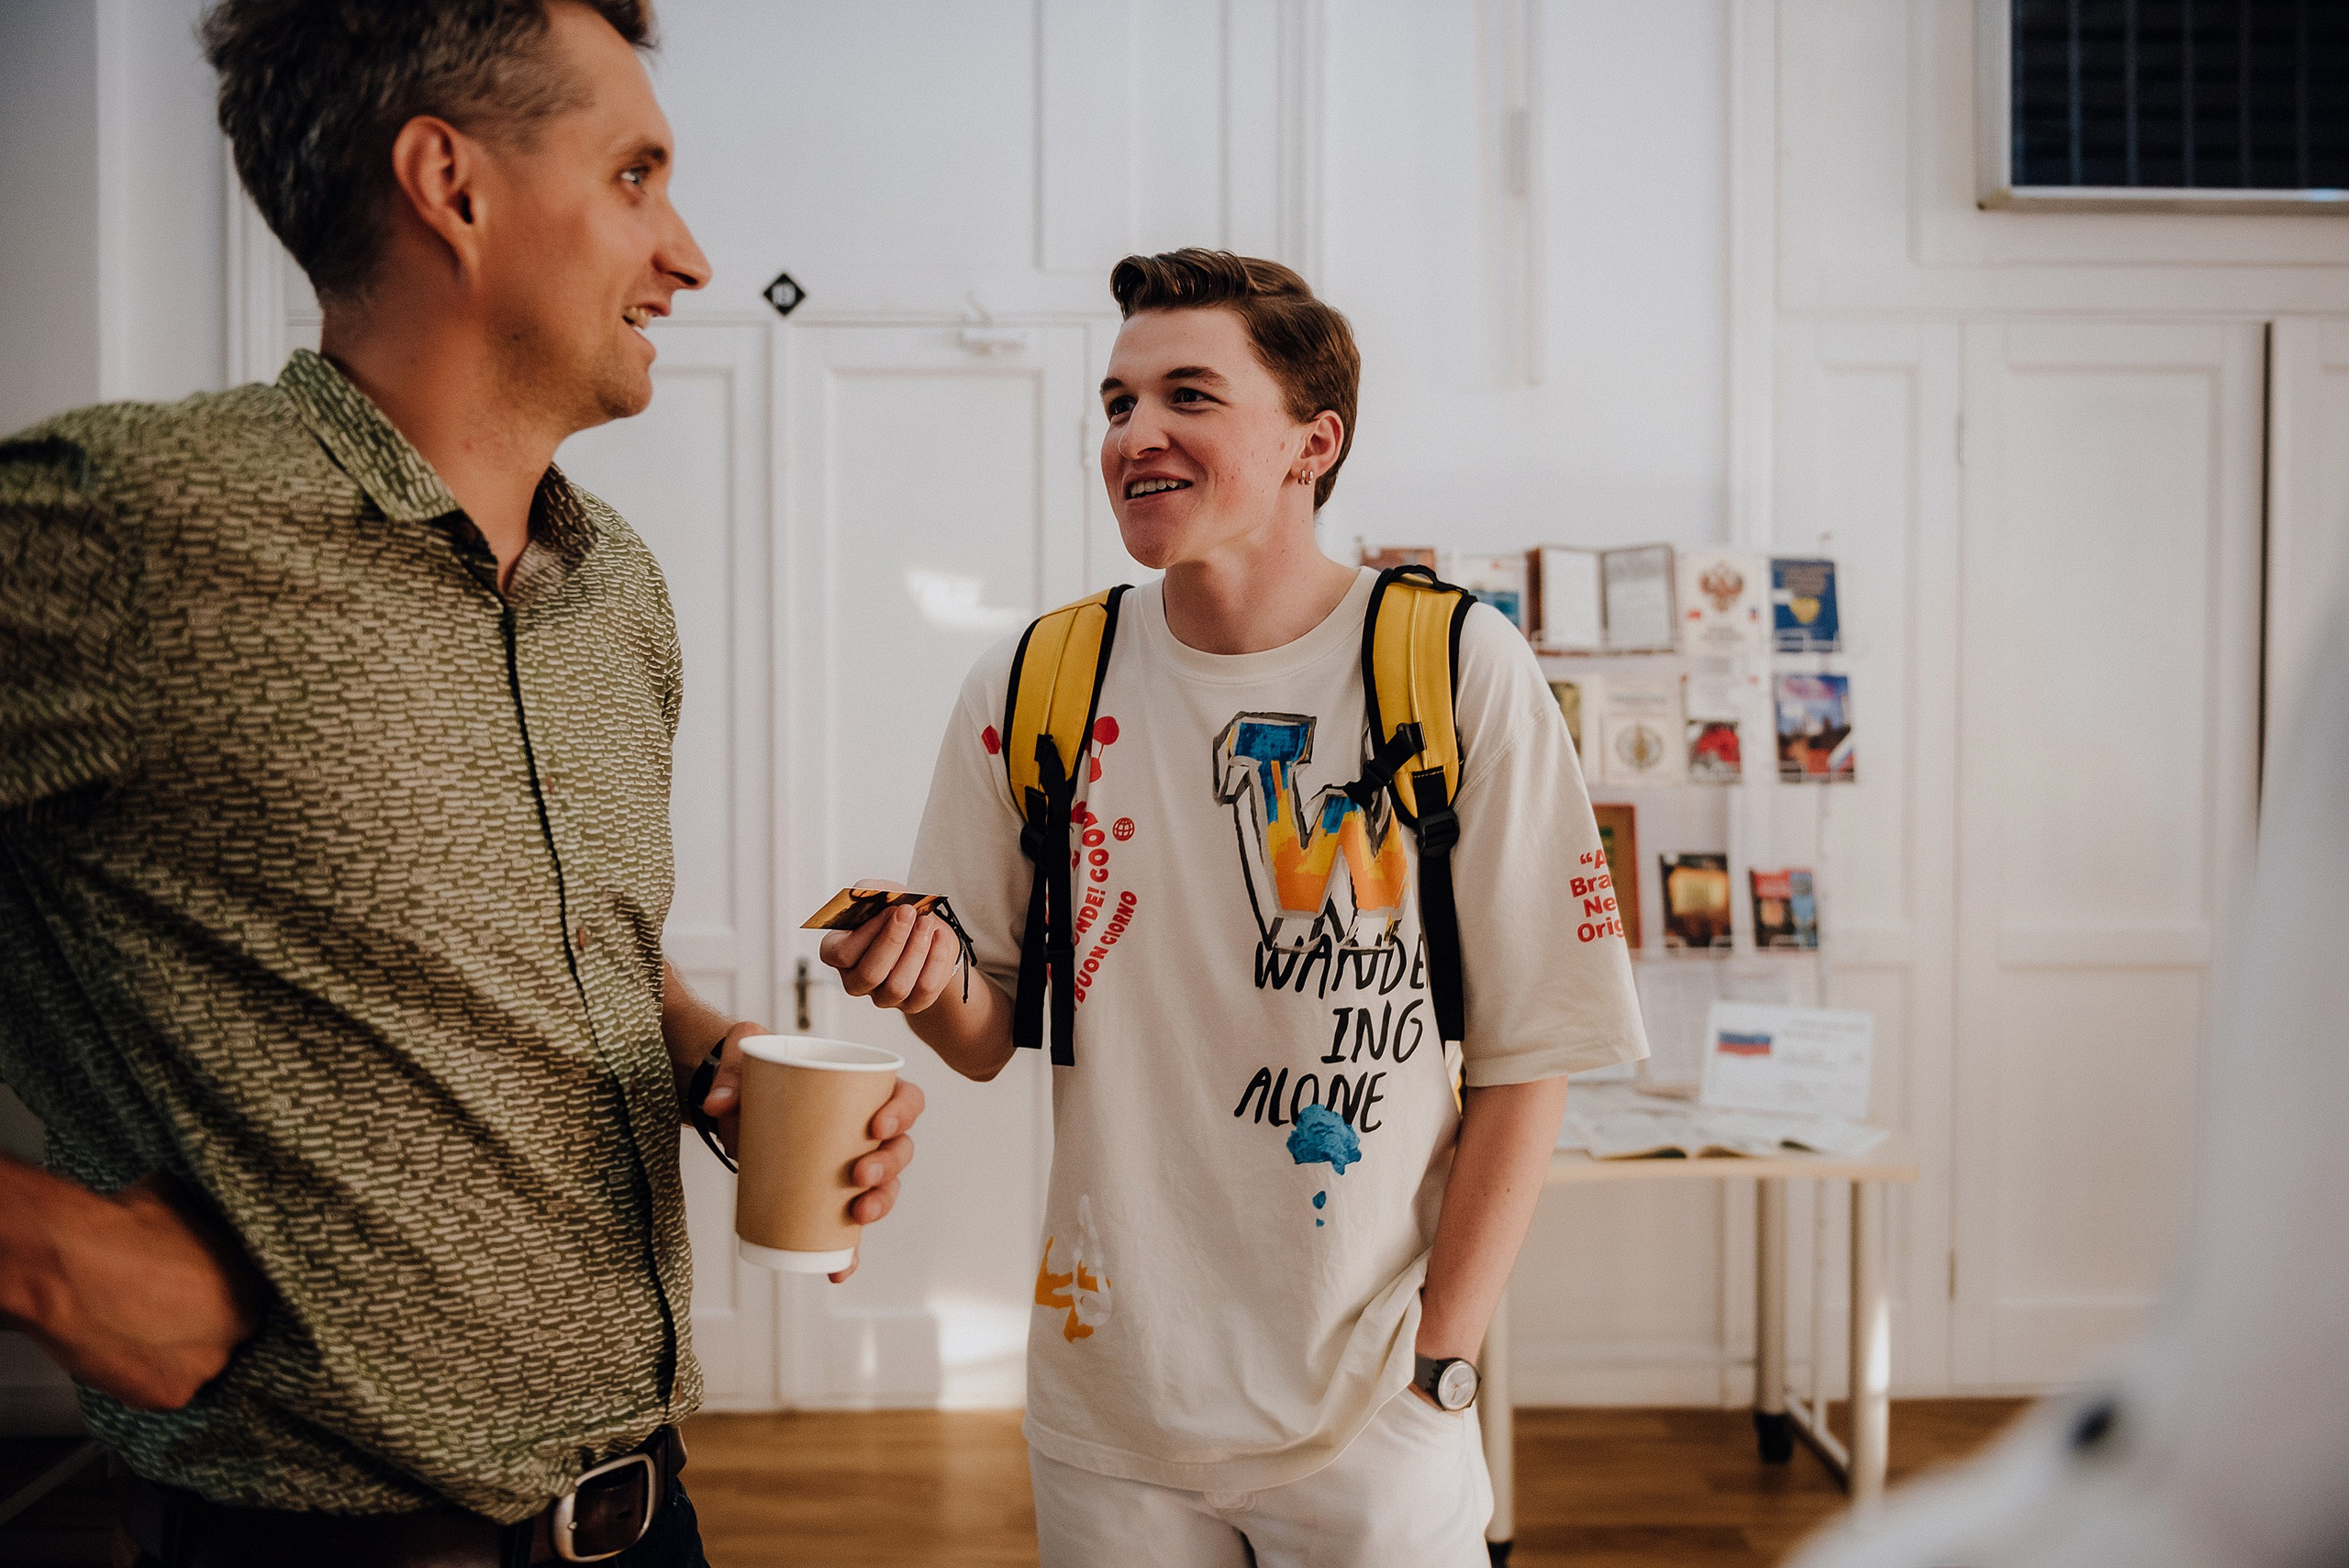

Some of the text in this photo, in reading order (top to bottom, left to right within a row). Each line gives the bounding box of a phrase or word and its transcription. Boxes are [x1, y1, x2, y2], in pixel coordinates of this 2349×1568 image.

[1074, 891, 1137, 1003] BUON GIORNO
[1254, 933, 1429, 999] WANDE
[1320, 999, 1423, 1064] ING
[1234, 1066, 1386, 1133] ALONE
